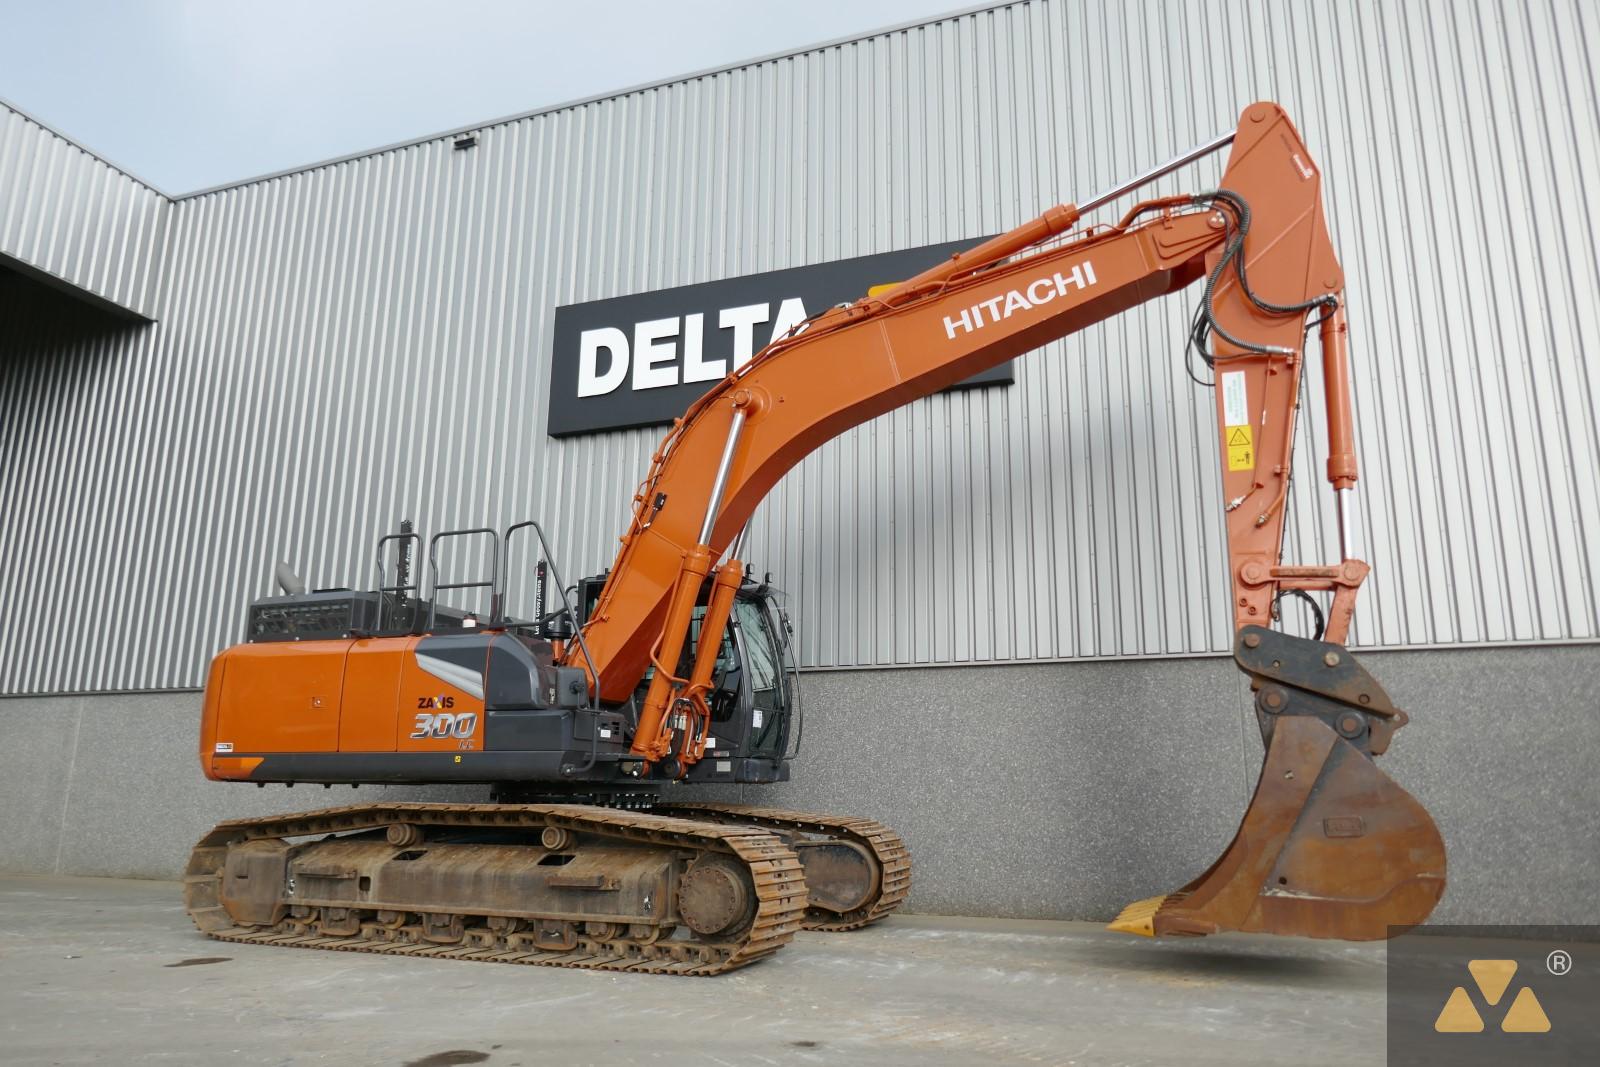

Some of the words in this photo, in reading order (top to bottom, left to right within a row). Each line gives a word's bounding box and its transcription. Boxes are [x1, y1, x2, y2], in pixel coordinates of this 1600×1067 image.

[943, 261, 1097, 339] HITACHI
[417, 696, 454, 709] ZAXIS
[410, 712, 477, 739] 300
